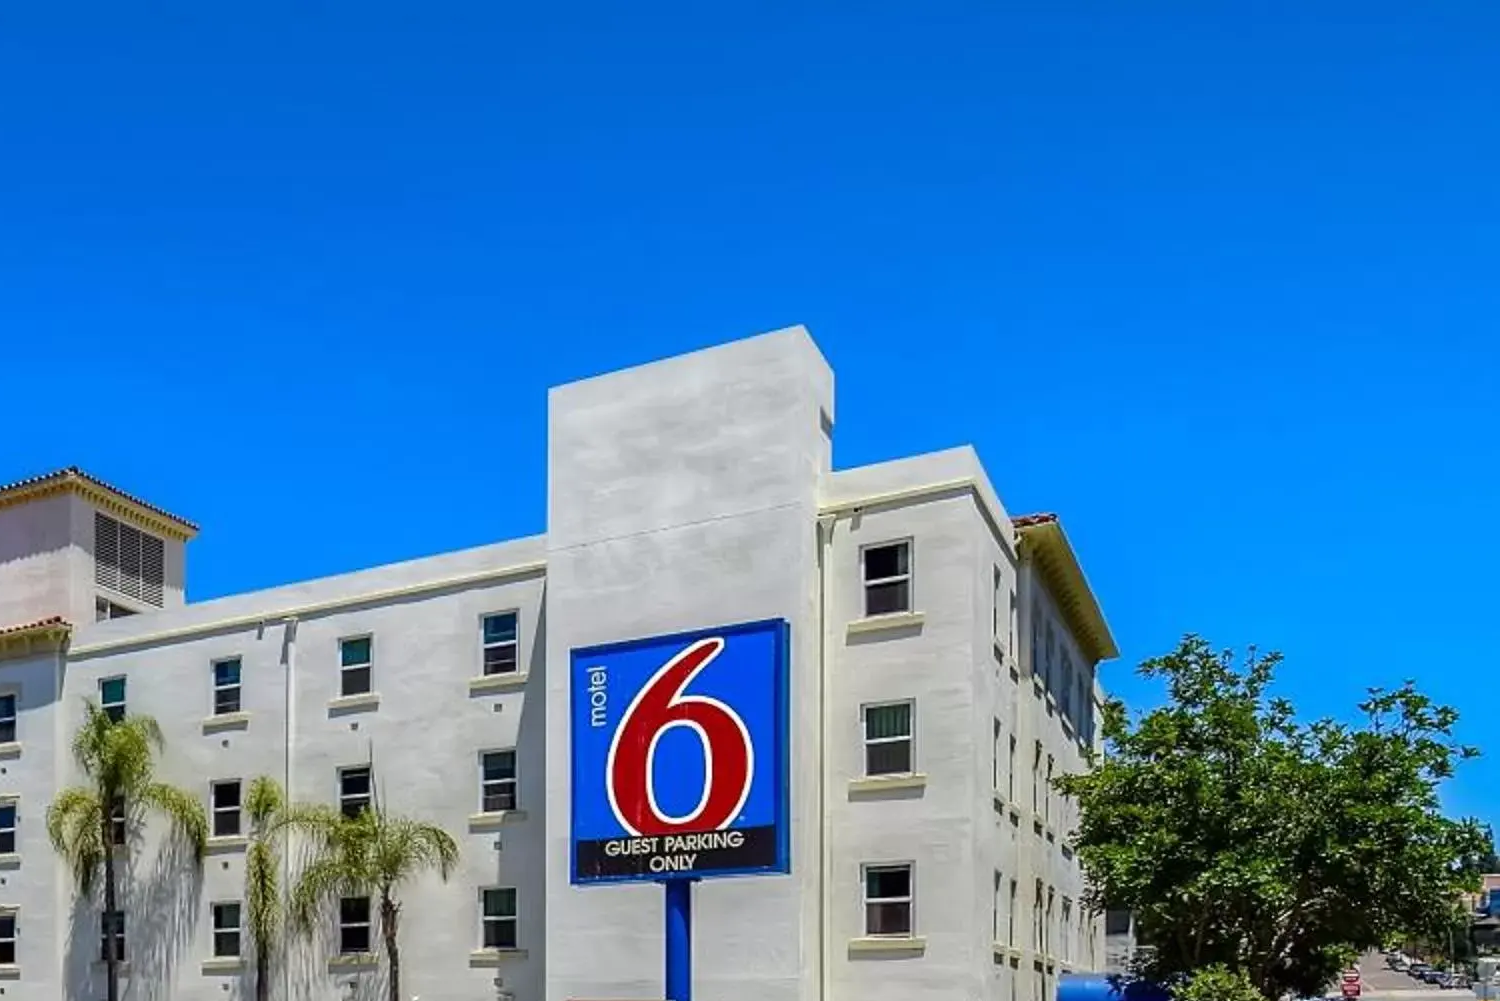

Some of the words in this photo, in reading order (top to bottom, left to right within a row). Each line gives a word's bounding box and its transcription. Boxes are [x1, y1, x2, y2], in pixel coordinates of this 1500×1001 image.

[587, 666, 608, 727] motel
[606, 636, 754, 836] 6
[605, 837, 660, 856] GUEST
[664, 831, 745, 854] PARKING
[650, 854, 697, 872] ONLY
